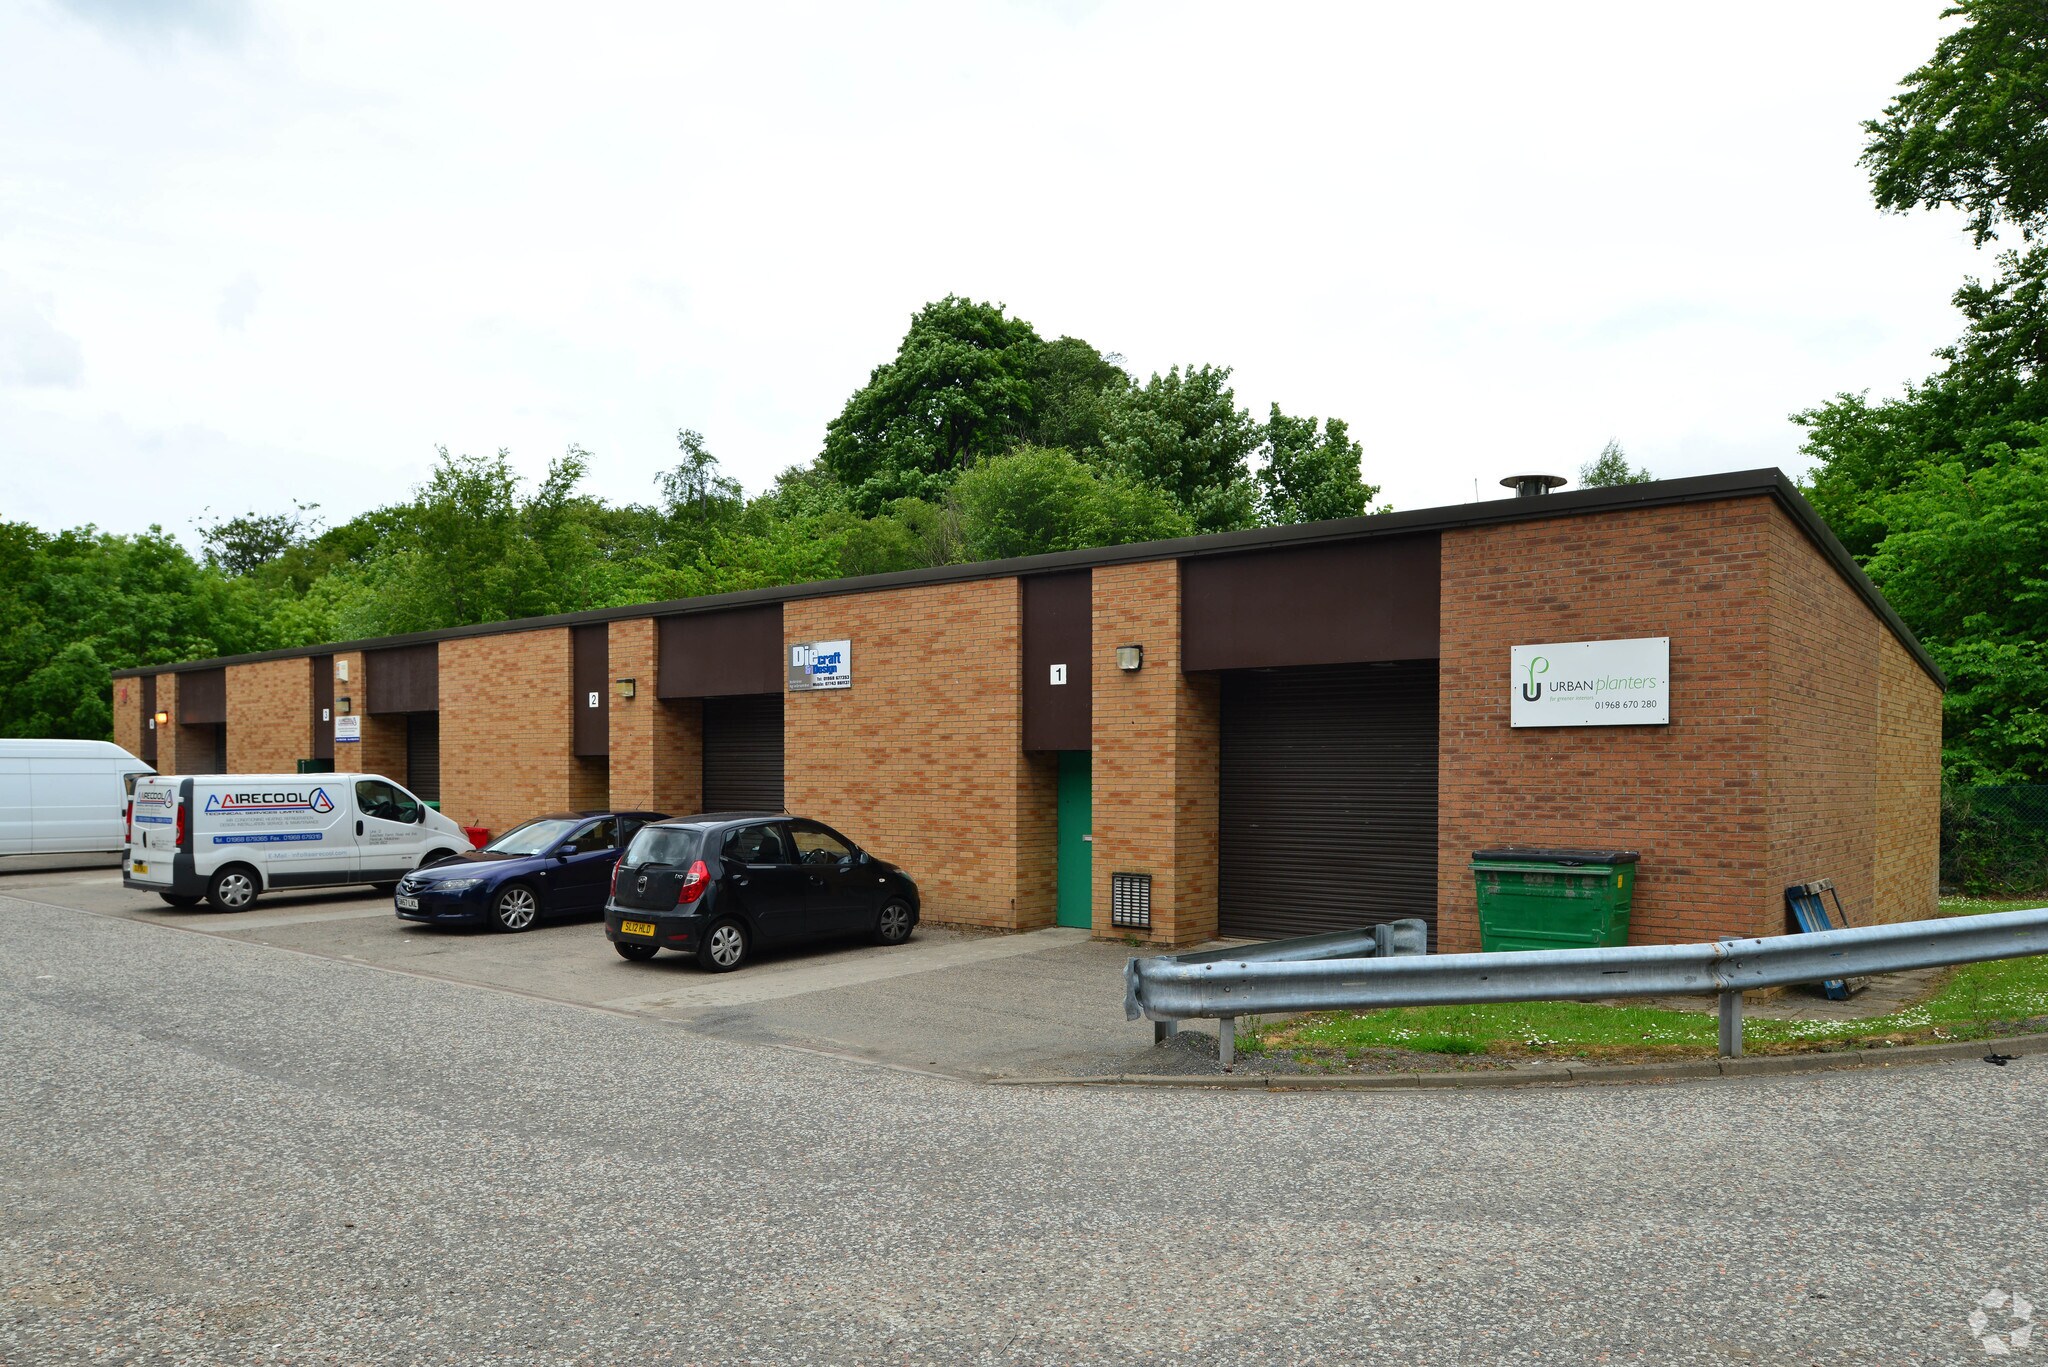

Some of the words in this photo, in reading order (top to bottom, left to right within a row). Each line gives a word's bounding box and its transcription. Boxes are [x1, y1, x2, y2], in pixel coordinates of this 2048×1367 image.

[813, 664, 837, 674] Design
[1055, 667, 1062, 682] 1
[1549, 680, 1594, 692] URBAN
[1595, 675, 1657, 695] planters
[591, 694, 597, 705] 2
[1595, 701, 1621, 709] 01968
[1623, 700, 1639, 709] 670
[1641, 700, 1657, 708] 280
[625, 922, 638, 932] SL12
[638, 924, 651, 934] HLD
